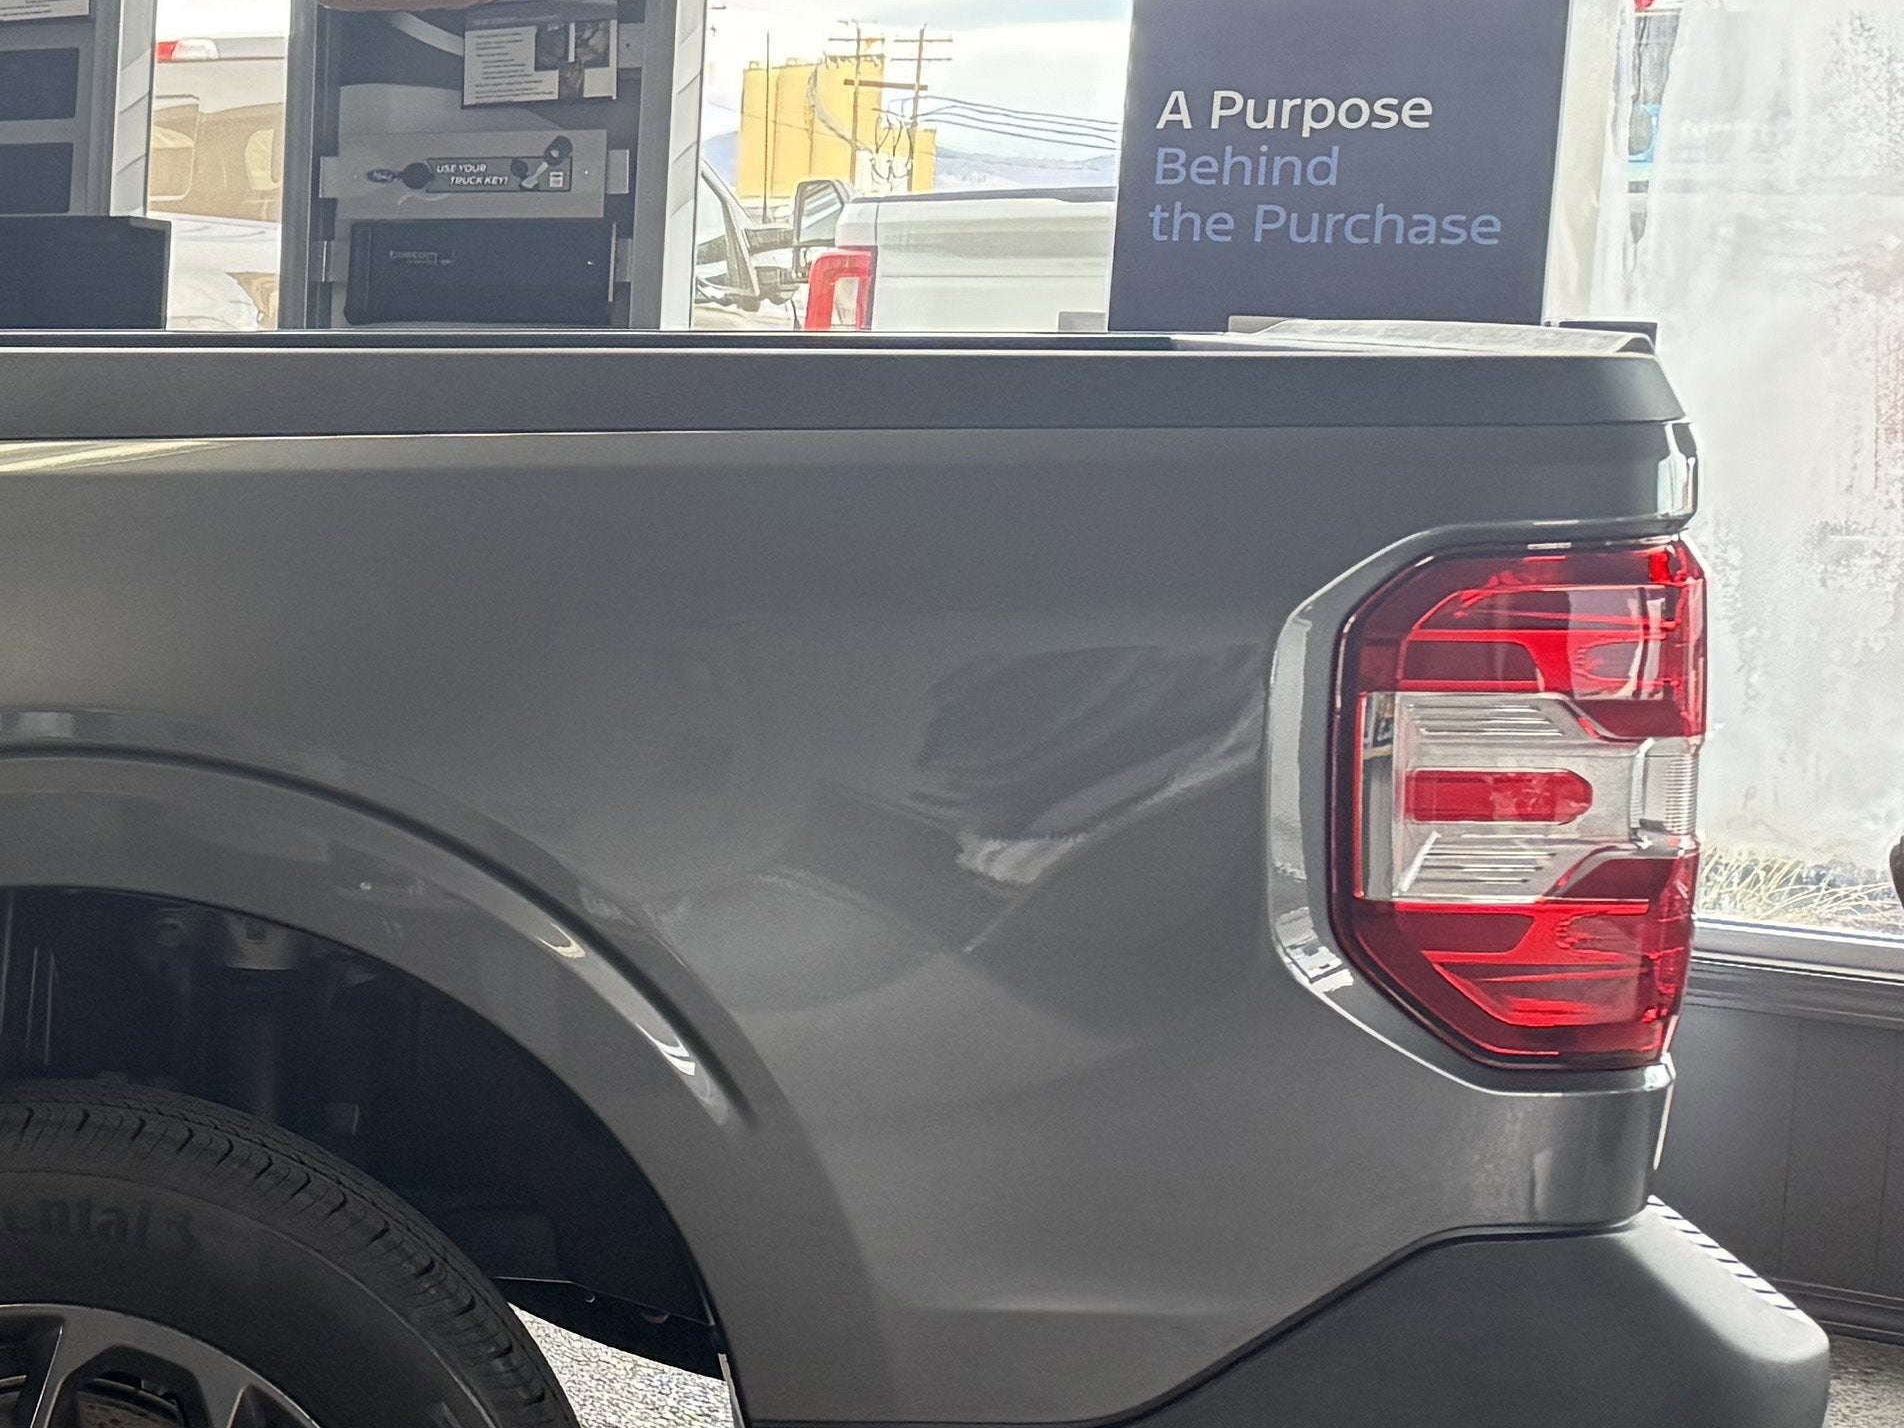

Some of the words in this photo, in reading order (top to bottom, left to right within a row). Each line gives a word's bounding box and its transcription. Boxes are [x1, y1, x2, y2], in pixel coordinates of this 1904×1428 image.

[1155, 89, 1193, 130] A
[1209, 89, 1434, 138] Purpose
[450, 176, 483, 185] TRUCK
[1154, 145, 1340, 187] Behind
[1148, 200, 1235, 243] the
[1253, 202, 1502, 246] Purchase
